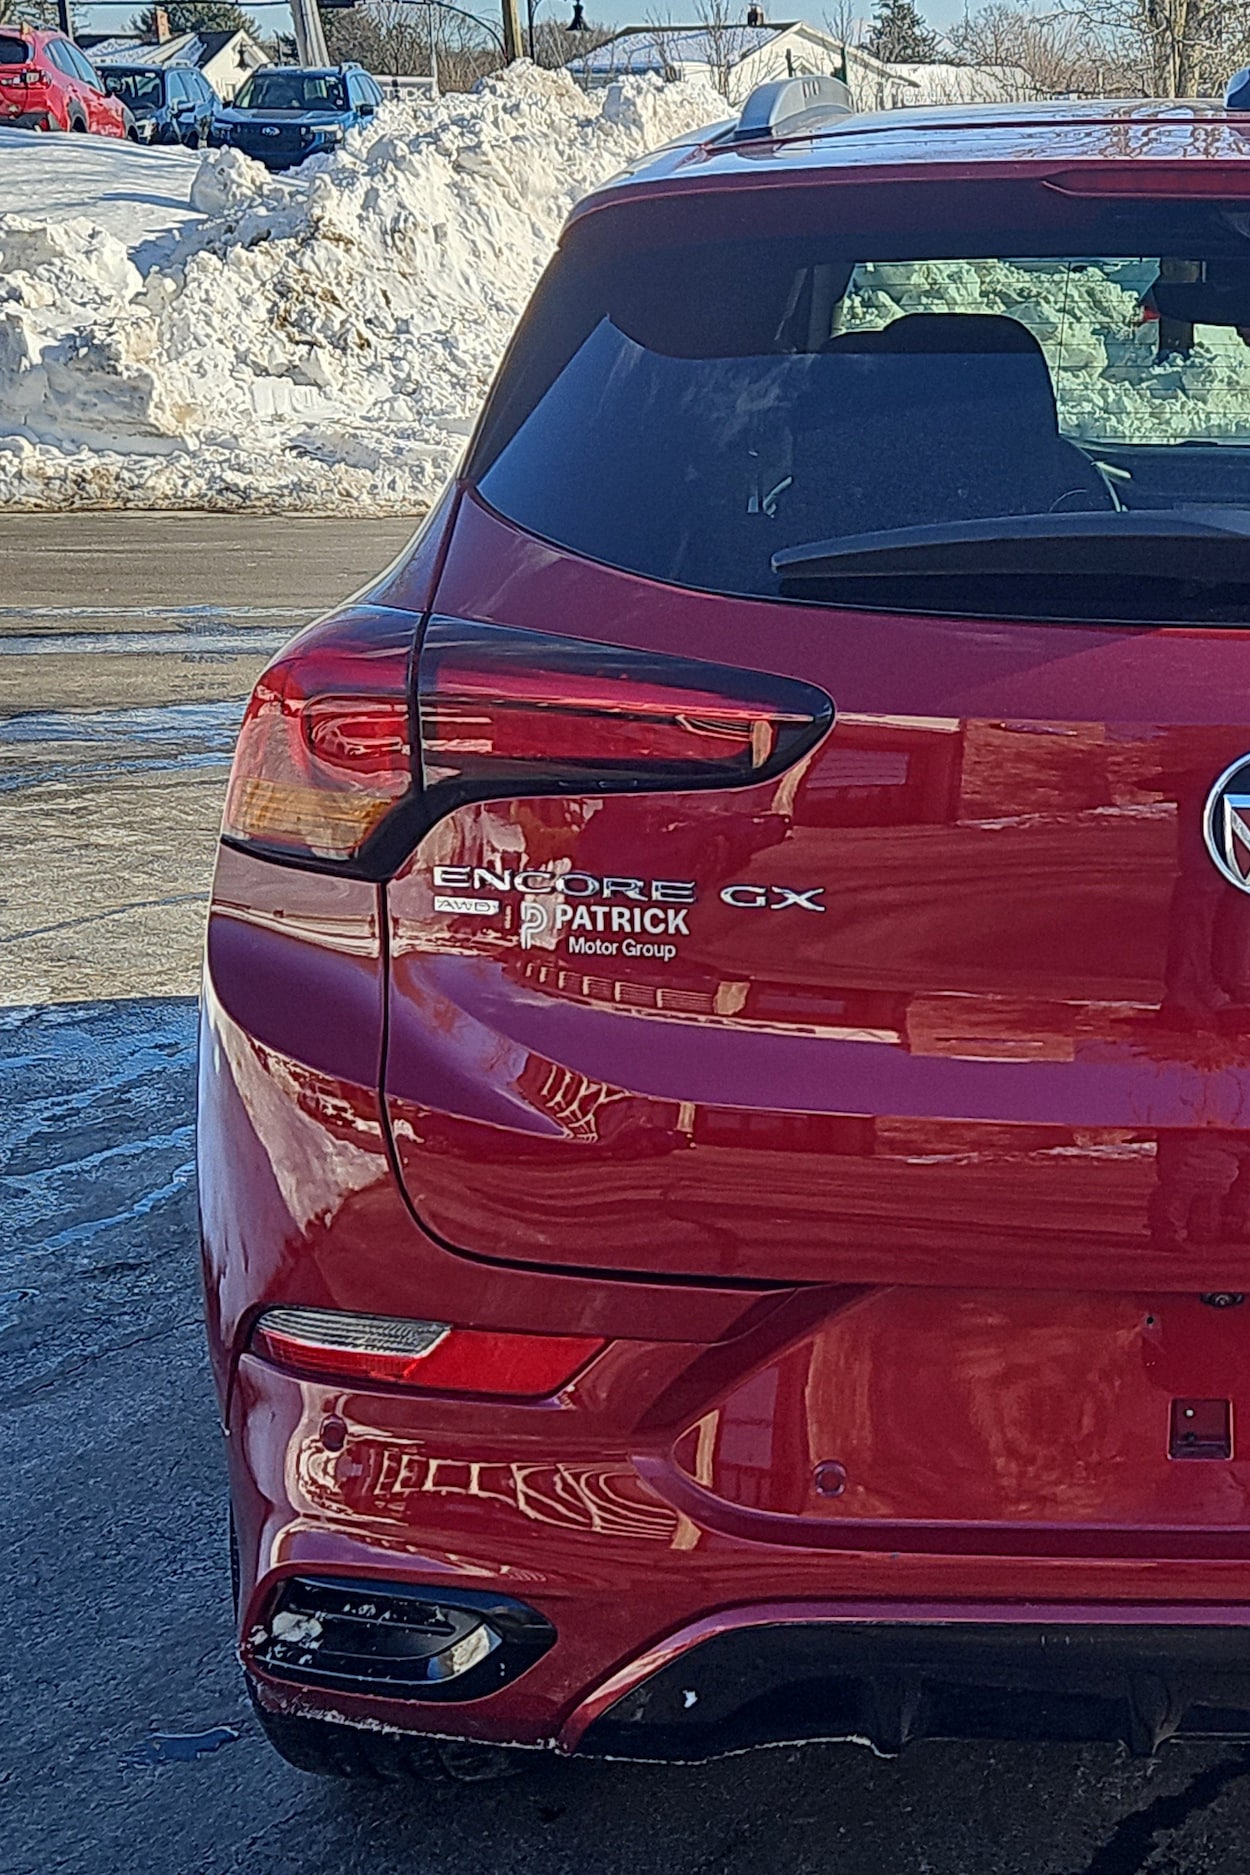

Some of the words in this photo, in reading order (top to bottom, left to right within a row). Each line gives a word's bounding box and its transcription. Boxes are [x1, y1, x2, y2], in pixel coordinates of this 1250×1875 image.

[433, 866, 697, 903] ENCORE
[719, 884, 827, 912] GX
[436, 898, 494, 914] AWD
[555, 904, 691, 935] PATRICK
[568, 936, 618, 956] Motor
[621, 938, 677, 962] Group
